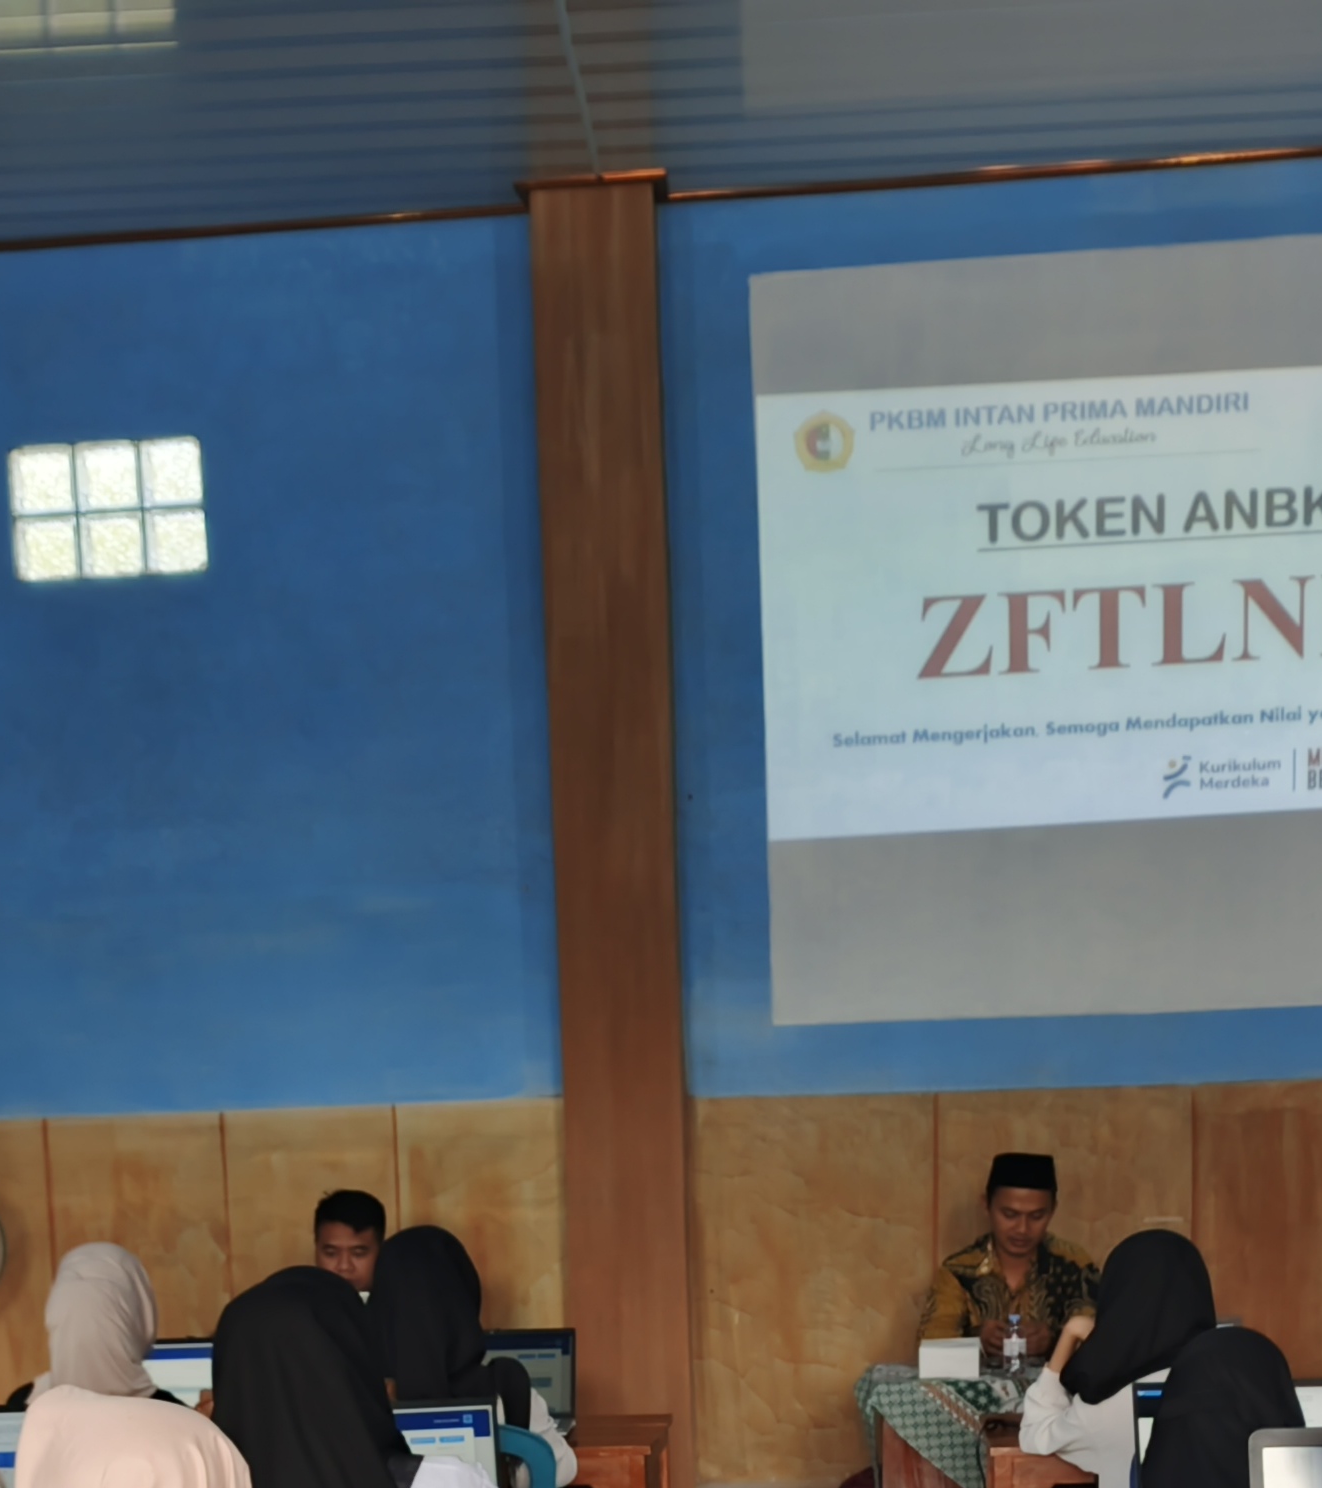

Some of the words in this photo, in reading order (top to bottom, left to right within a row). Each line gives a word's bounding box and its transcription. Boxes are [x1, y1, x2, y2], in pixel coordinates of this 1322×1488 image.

[869, 407, 946, 431] PKBM
[953, 403, 1035, 428] INTAN
[1043, 399, 1129, 423] PRIMA
[1134, 392, 1250, 418] MANDIRI
[976, 493, 1166, 545] TOKEN
[832, 731, 907, 748] Selamat
[1045, 720, 1121, 738] Semoga
[1125, 710, 1255, 733] Mendapatkan
[1259, 705, 1303, 724] Nilai
[1198, 757, 1282, 774] Kurikulum
[1198, 773, 1271, 791] Merdeka
